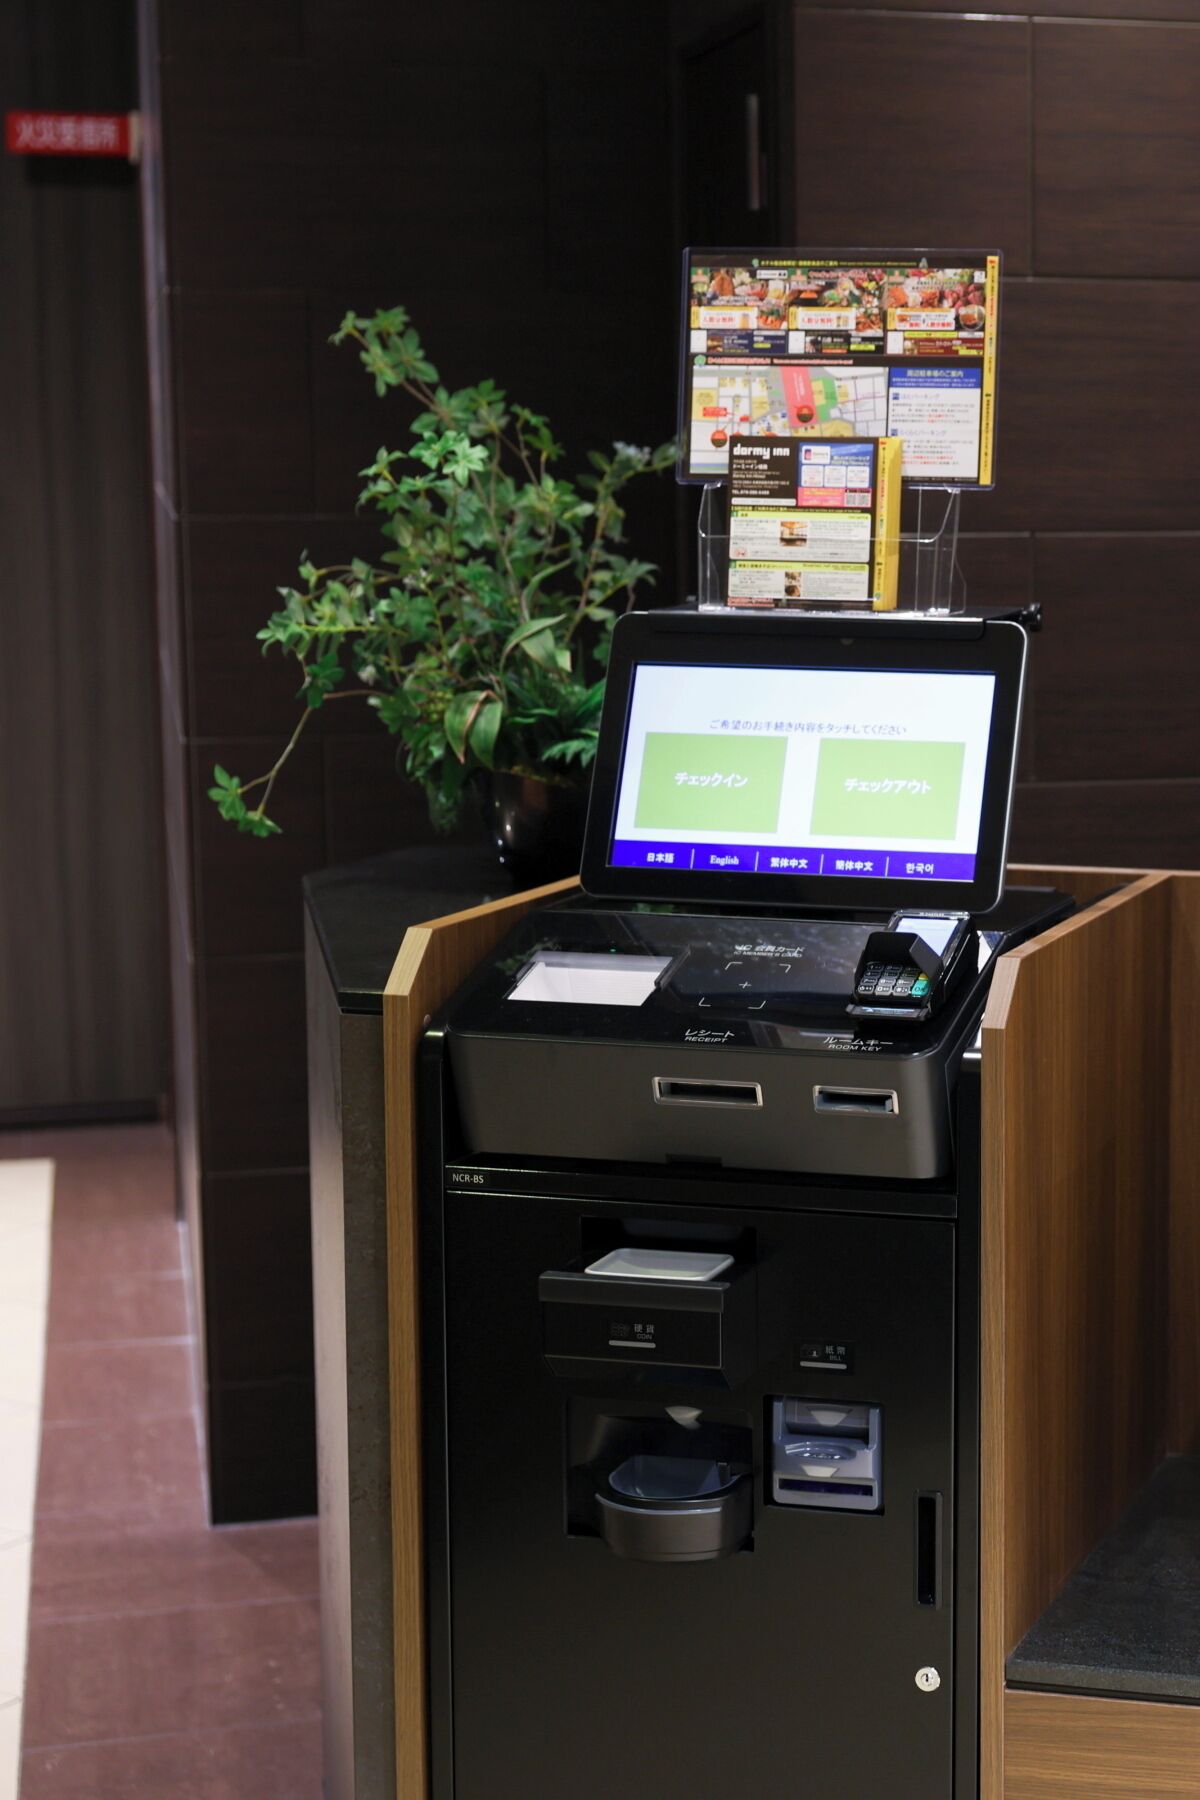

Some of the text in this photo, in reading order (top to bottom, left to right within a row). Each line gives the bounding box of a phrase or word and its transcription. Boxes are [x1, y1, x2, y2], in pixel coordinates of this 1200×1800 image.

[733, 443, 770, 460] dormy
[773, 447, 790, 456] inn
[709, 719, 907, 736] ご希望のお手続き内容をタッチしてください
[674, 771, 932, 795] チェックイン チェックアウト
[646, 852, 674, 864] 日本語
[709, 854, 739, 867] English
[905, 862, 935, 875] 한국어
[684, 1028, 735, 1038] レシート
[823, 1035, 893, 1046] ルームキー
[828, 1043, 859, 1051] ROOM
[452, 1173, 484, 1184] NCR-BS
